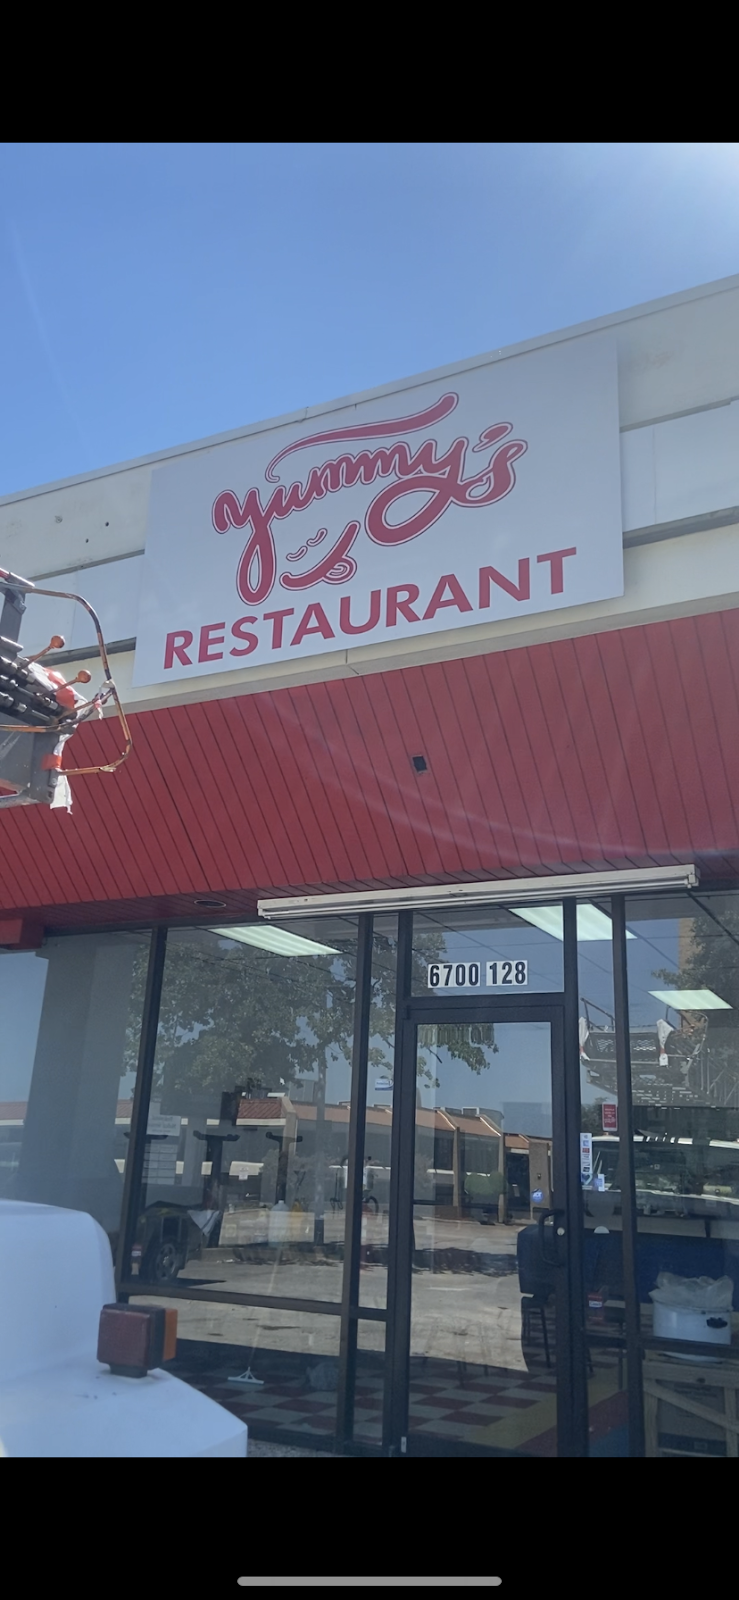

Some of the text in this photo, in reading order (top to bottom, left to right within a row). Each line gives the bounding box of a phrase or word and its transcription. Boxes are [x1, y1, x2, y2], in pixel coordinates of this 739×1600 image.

[163, 547, 577, 669] RESTAURANT
[429, 961, 526, 987] 6700 128
